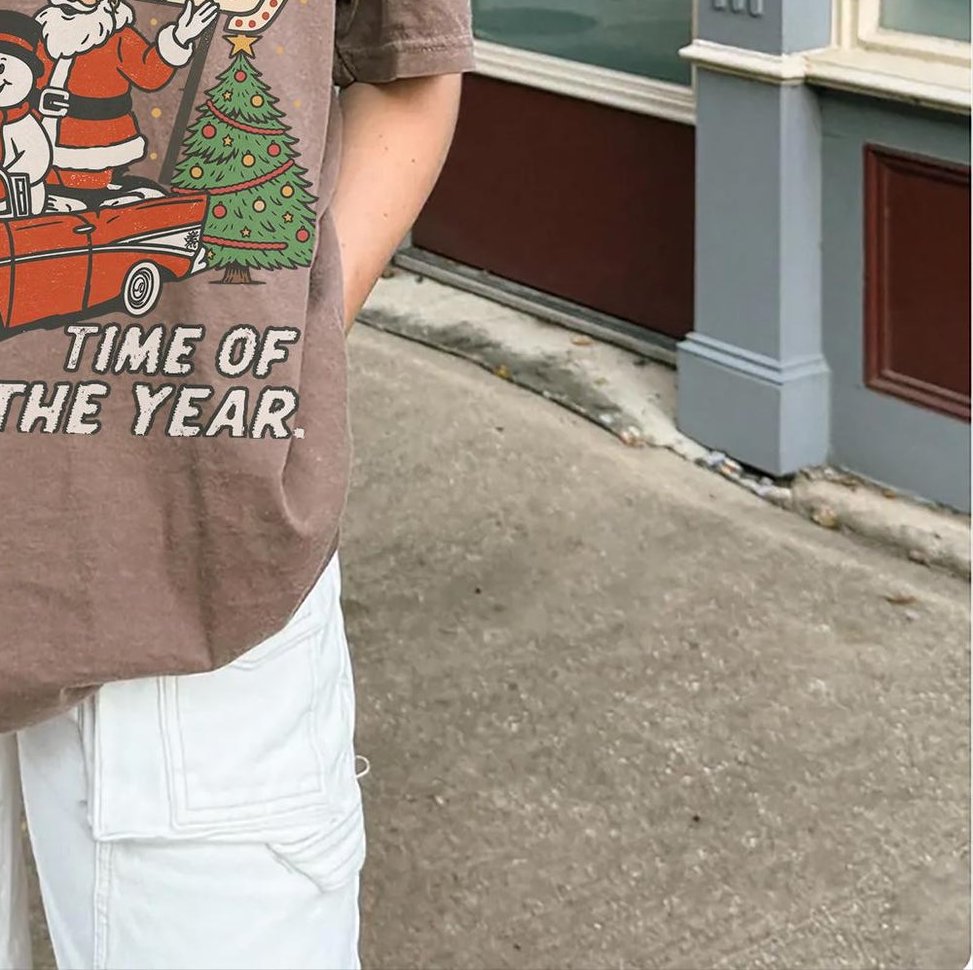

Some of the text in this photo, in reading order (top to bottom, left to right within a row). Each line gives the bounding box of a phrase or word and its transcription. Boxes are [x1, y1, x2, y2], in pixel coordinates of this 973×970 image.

[64, 322, 301, 379] TIME OF
[132, 383, 305, 440] YEAR.
